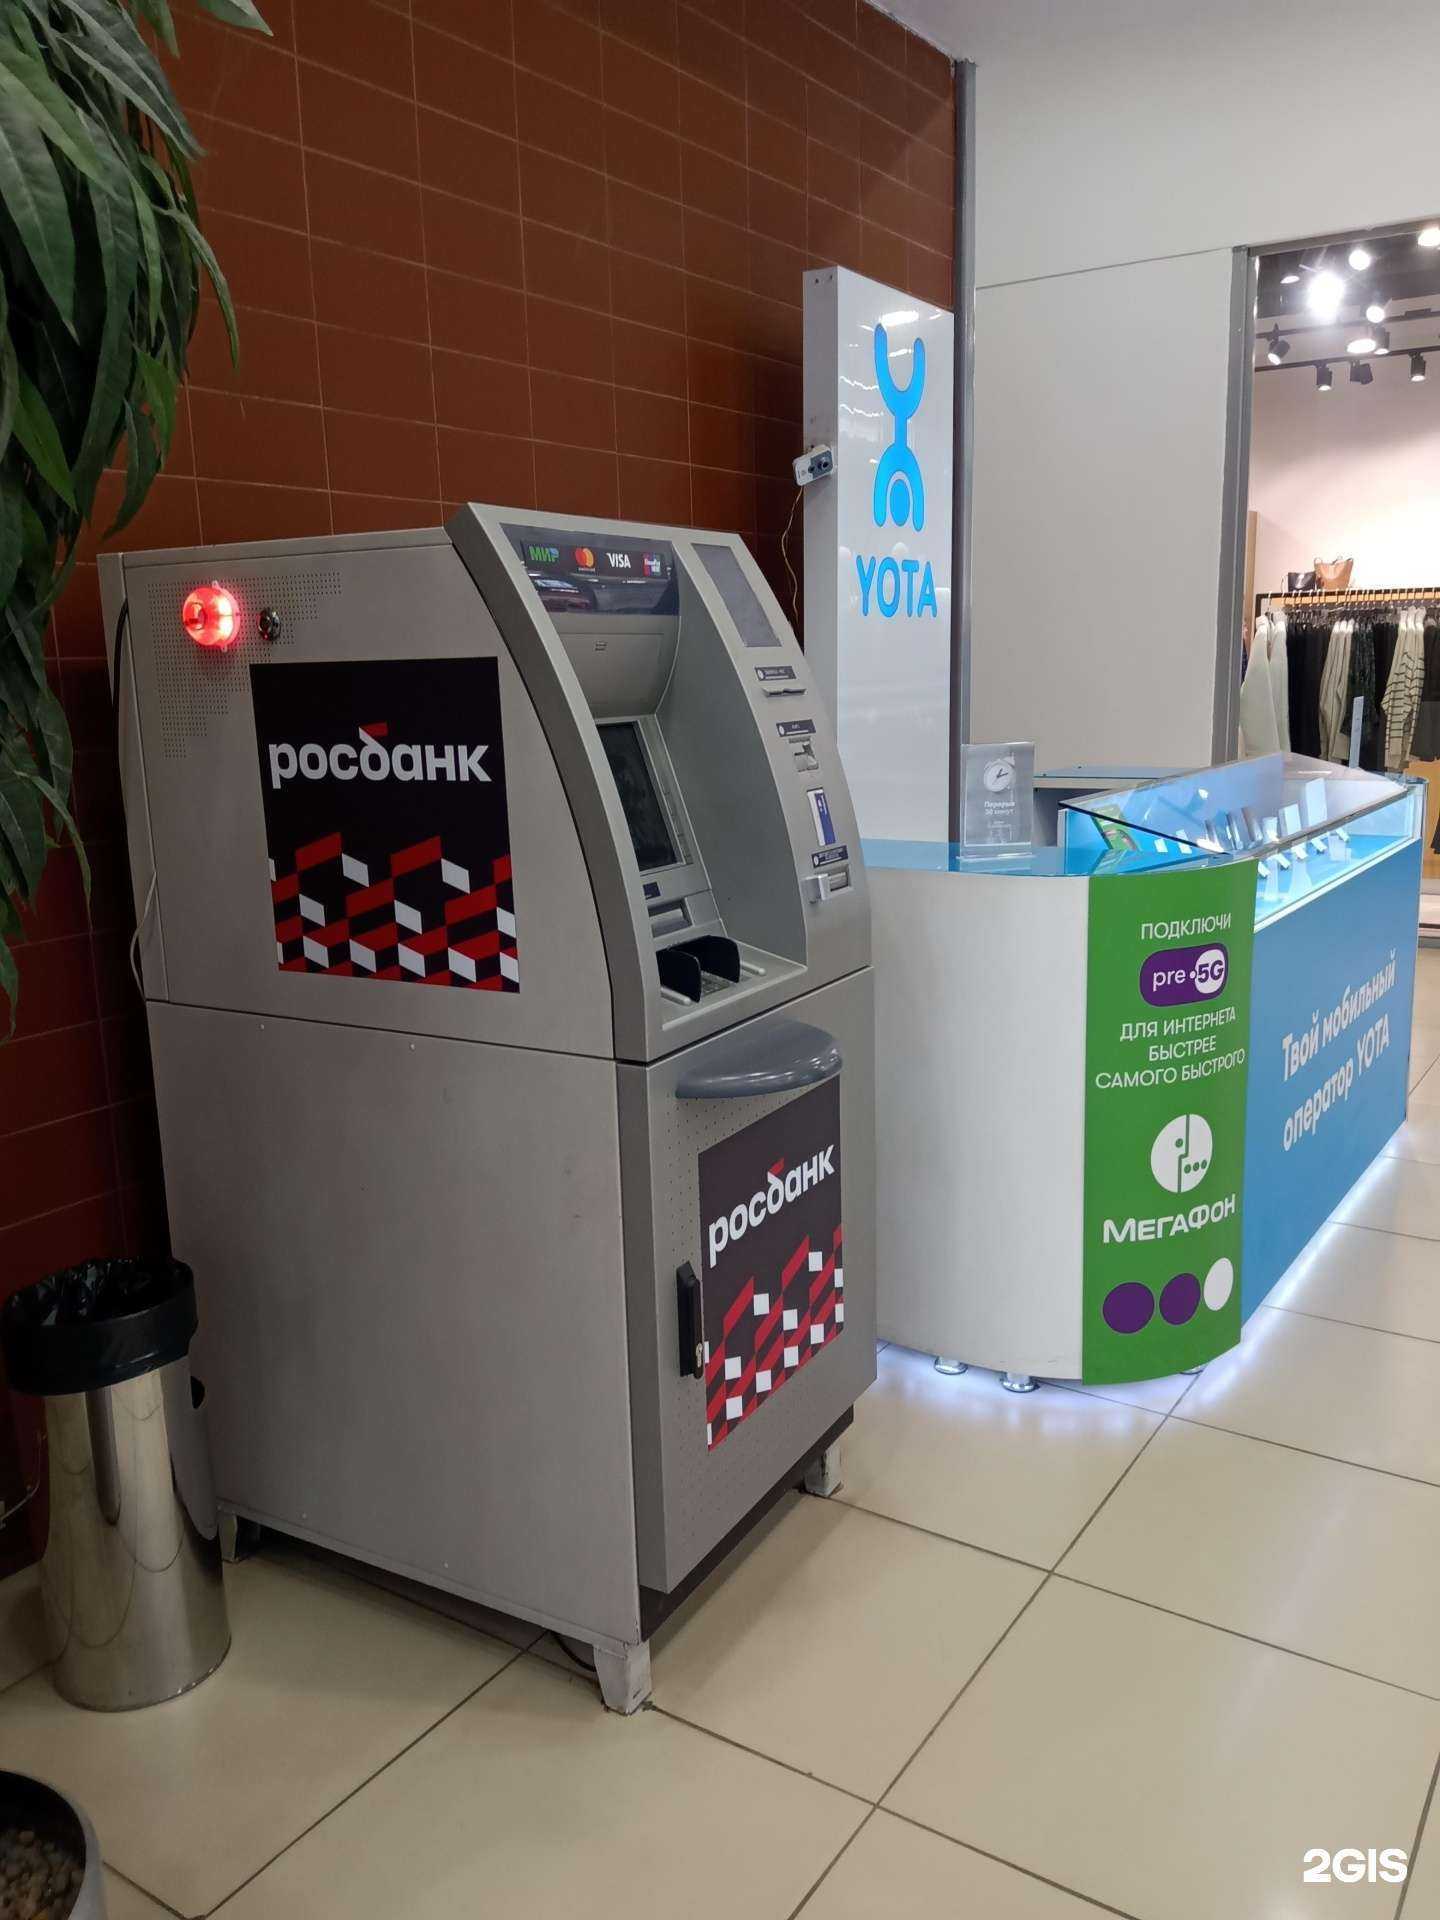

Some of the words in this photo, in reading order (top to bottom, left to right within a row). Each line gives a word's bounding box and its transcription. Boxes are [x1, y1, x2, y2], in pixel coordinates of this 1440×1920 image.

[529, 546, 559, 562] МИР
[606, 553, 631, 568] VISA
[856, 555, 937, 618] YOTA
[269, 722, 492, 789] росбанк
[1141, 913, 1231, 940] ПОДКЛЮЧИ
[1120, 1022, 1158, 1042] ДЛЯ
[1163, 1006, 1236, 1036] ИНТЕРНЕТА
[1282, 1009, 1319, 1081] Твой
[1322, 948, 1396, 1047] мобильный
[1095, 1067, 1178, 1089] САМОГО
[1181, 1048, 1246, 1081] БЫСТРОГО
[1149, 1035, 1217, 1062] БЫСТРЕЕ
[1283, 1058, 1354, 1151] оператор
[1357, 1014, 1390, 1076] YOTA
[708, 1144, 835, 1268] росбанк
[1103, 1193, 1236, 1243] МЕГАФОН
